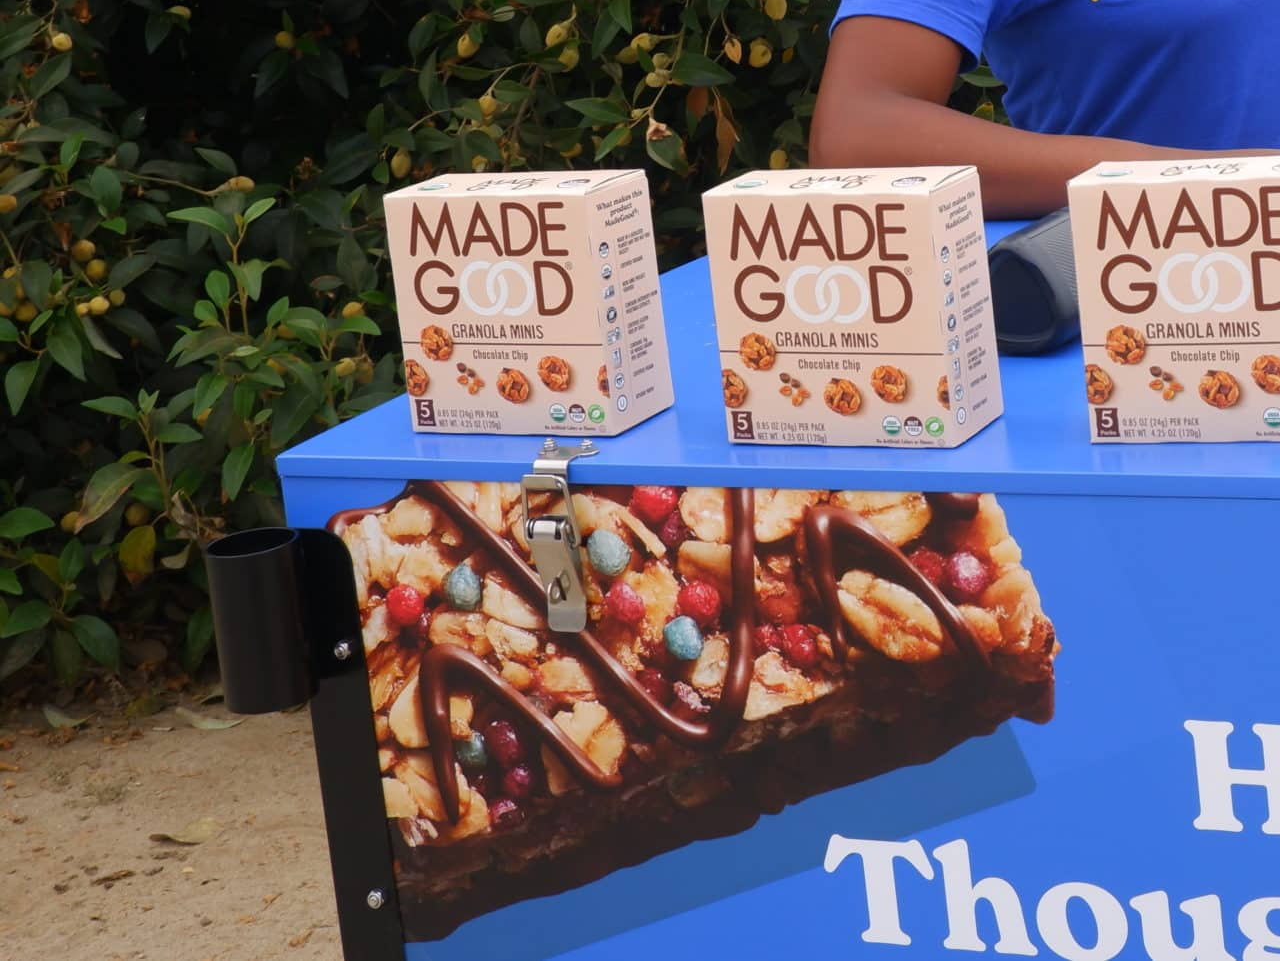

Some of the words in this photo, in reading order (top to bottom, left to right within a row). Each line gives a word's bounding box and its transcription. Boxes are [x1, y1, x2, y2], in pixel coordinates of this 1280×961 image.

[410, 201, 569, 257] MADE
[730, 202, 909, 262] MADE
[414, 260, 573, 316] GOOD
[734, 264, 913, 324] GOOD
[452, 323, 507, 340] GRANOLA
[509, 324, 544, 339] MINIS
[1146, 322, 1214, 339] GRANOLA
[1219, 321, 1261, 338] MINIS
[775, 331, 837, 348] GRANOLA
[840, 332, 879, 348] MINIS
[472, 349, 510, 360] Chocolate
[511, 350, 528, 361] Chip
[1170, 350, 1217, 362] Chocolate
[1219, 350, 1240, 363] Chip
[798, 359, 839, 370] Chocolate
[841, 360, 861, 372] Chip
[420, 401, 430, 418] 5
[737, 413, 748, 430] 5
[1101, 410, 1113, 428] 5
[1139, 418, 1147, 426] OZ
[1170, 417, 1181, 426] PER
[1183, 417, 1199, 426] PACK
